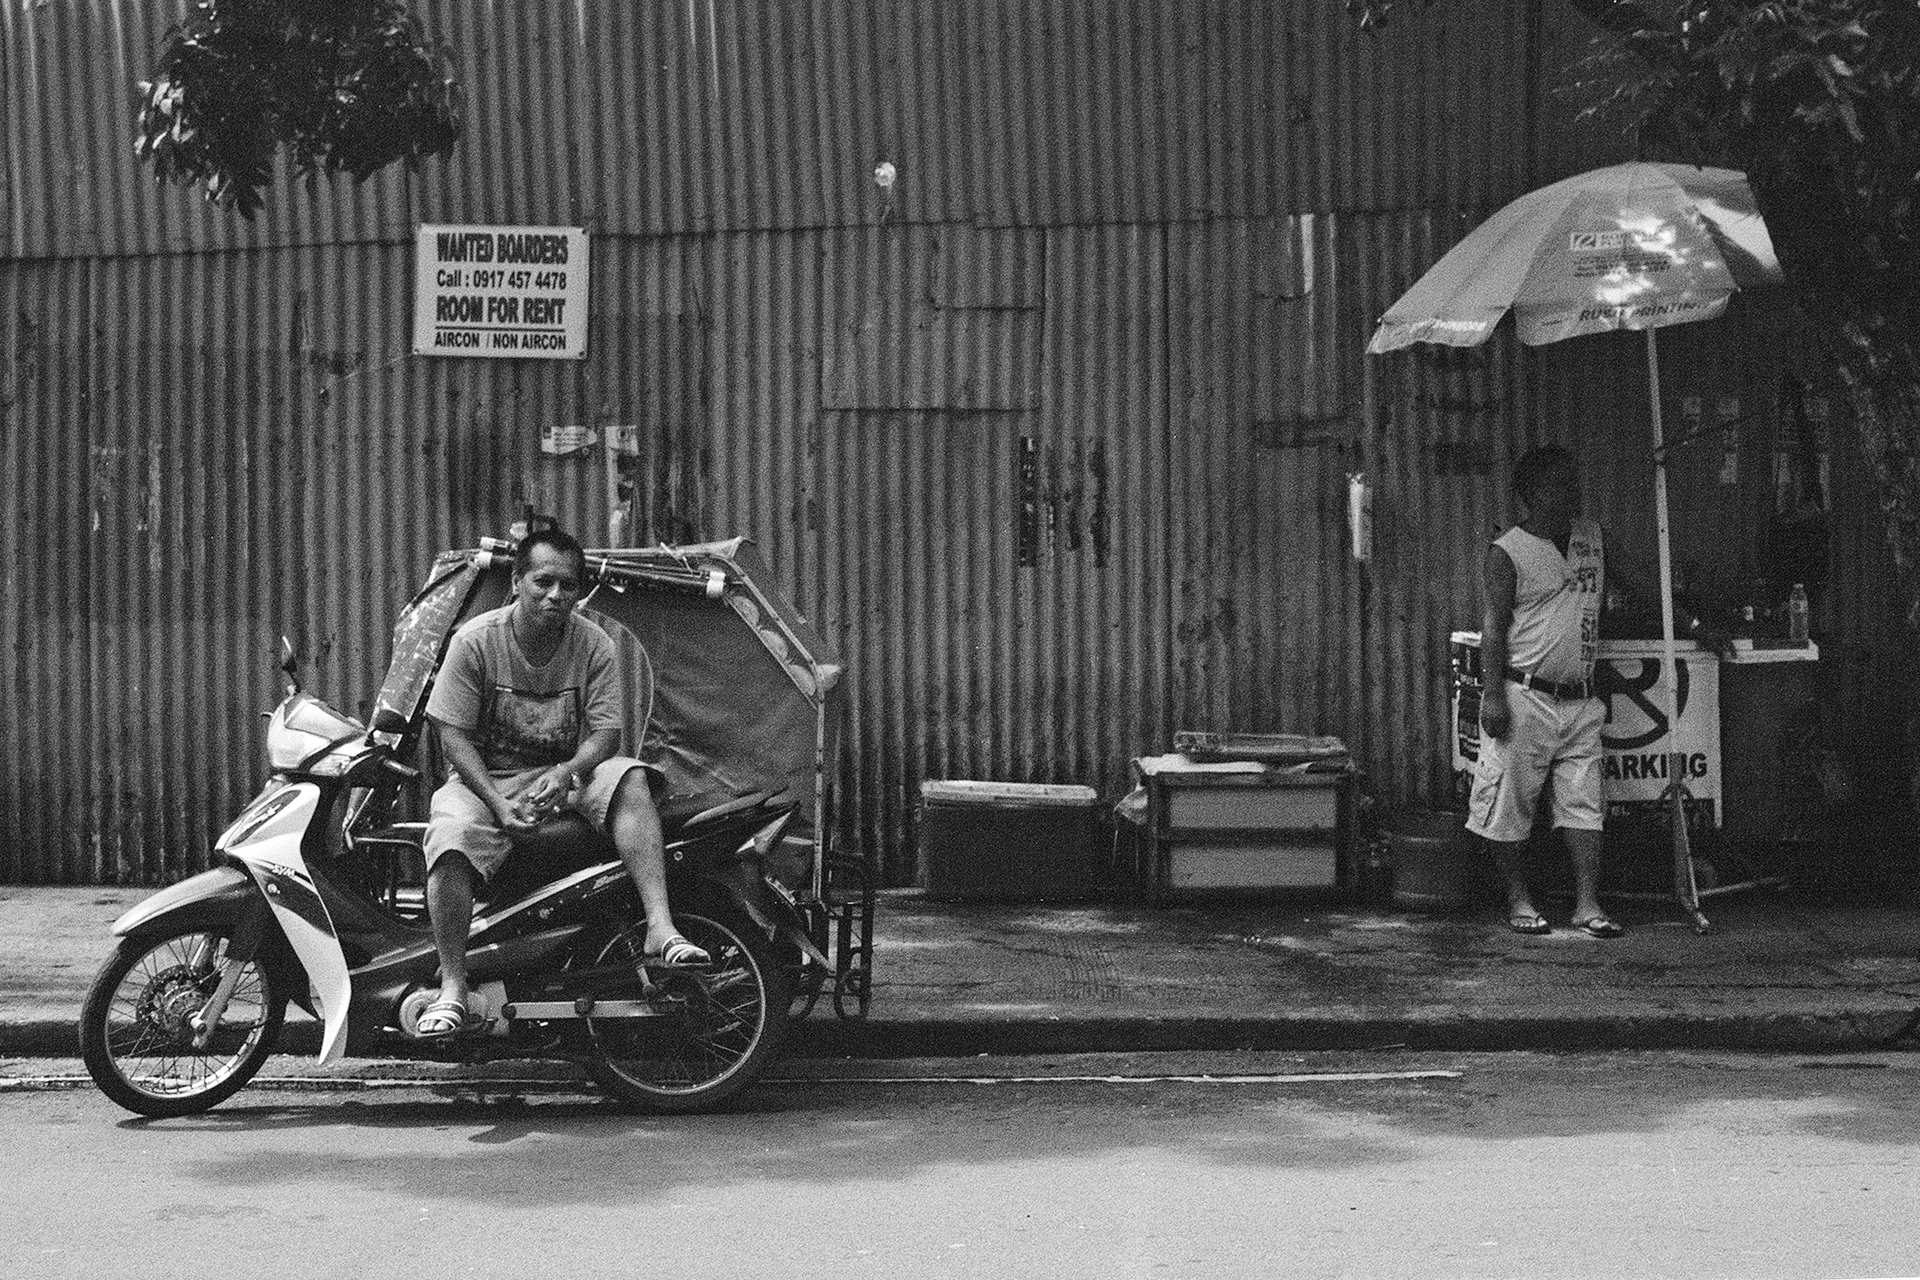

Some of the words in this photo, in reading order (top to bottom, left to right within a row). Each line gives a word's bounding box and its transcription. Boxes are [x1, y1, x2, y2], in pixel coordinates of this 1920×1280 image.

[437, 232, 494, 263] WANTED
[497, 234, 568, 264] BOARDERS
[437, 269, 462, 288] Call
[473, 270, 504, 288] 0917
[508, 271, 531, 289] 457
[535, 272, 567, 290] 4478
[436, 295, 484, 323] ROOM
[487, 297, 519, 324] FOR
[523, 298, 567, 325] RENT
[1632, 302, 1703, 317] PRINTIN
[435, 332, 480, 348] AIRCON
[493, 333, 518, 349] NON
[521, 334, 567, 350] AIRCON
[1601, 752, 1708, 780] ARKIG
